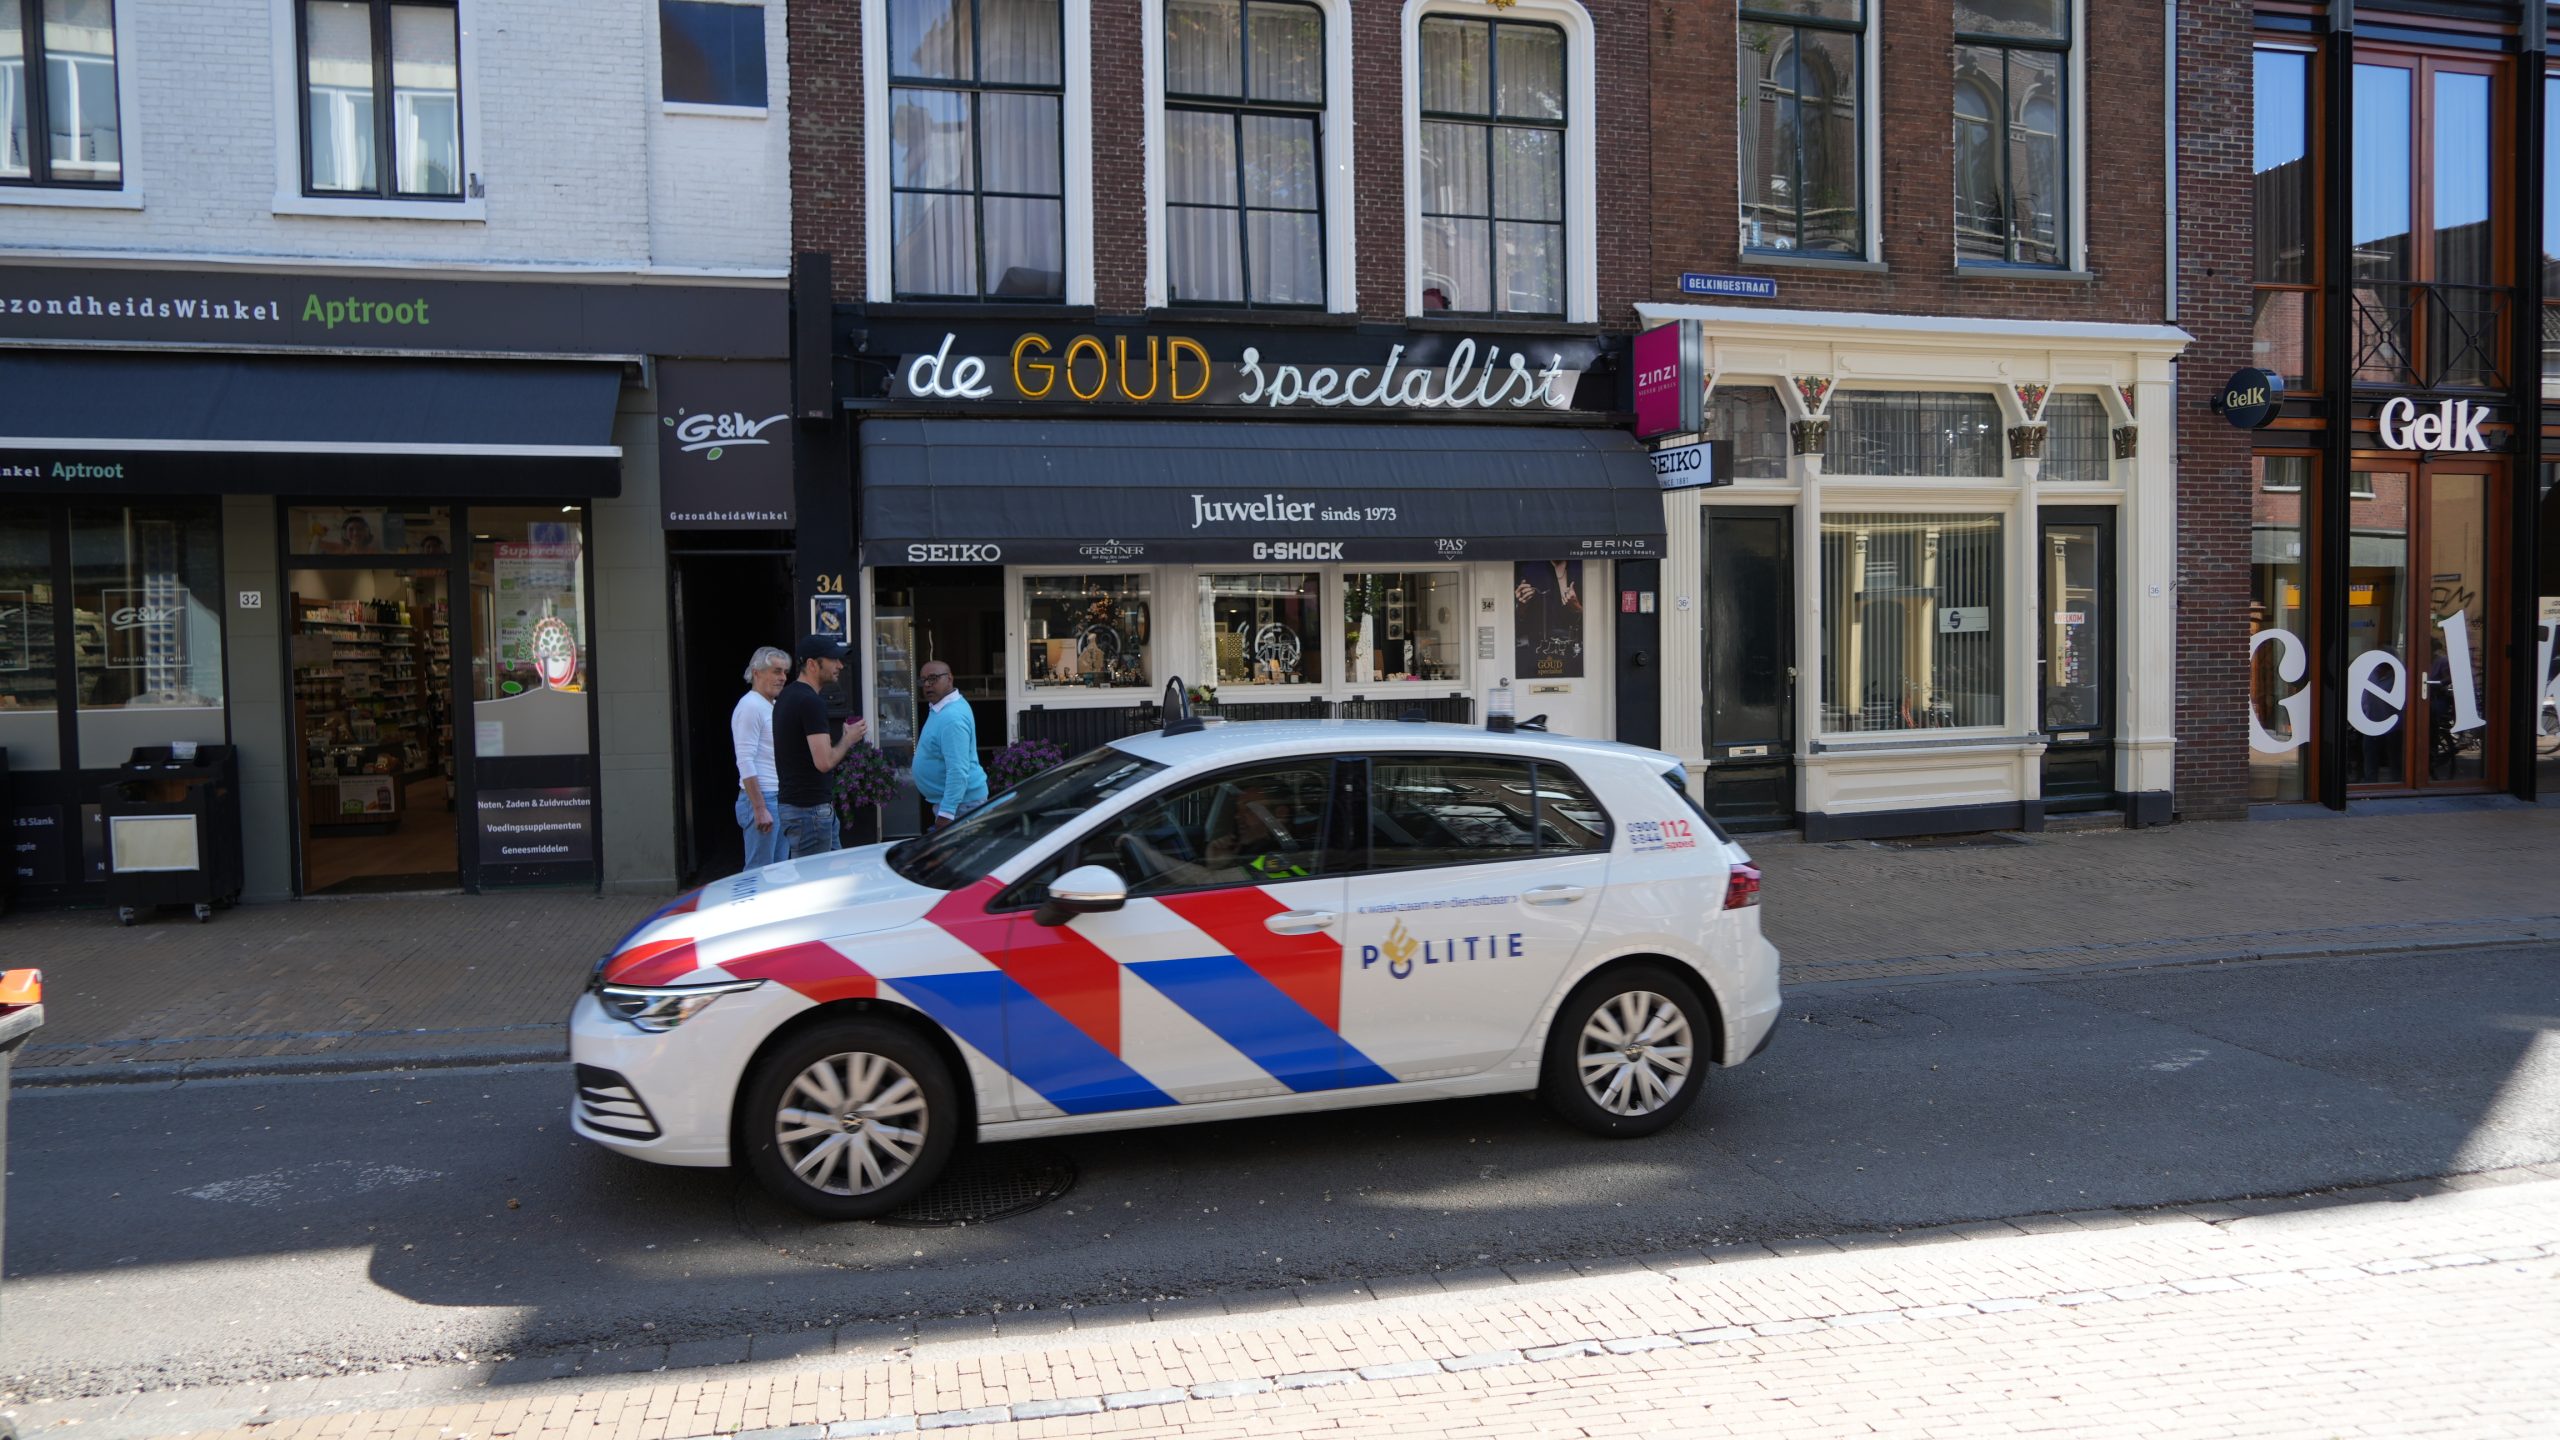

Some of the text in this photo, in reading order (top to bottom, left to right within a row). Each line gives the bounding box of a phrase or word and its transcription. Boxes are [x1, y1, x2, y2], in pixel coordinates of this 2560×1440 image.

[1689, 277, 1770, 293] GELKINGESTRAAT
[302, 293, 430, 329] Aptroot
[907, 332, 1565, 408] de GOUD specialist
[2226, 385, 2265, 407] Gelk
[676, 411, 789, 443] G&W
[2379, 397, 2490, 451] Gelk
[52, 462, 124, 481] Aptroot
[670, 511, 788, 521] GezondheidsWinkel
[1191, 493, 1397, 529] Juwelier sinds 1973
[907, 543, 1001, 563] SEIKO
[1079, 546, 1144, 555] GERSTNER
[1253, 542, 1344, 560] G-SHOCK
[1439, 538, 1463, 551] PAS
[1582, 540, 1645, 548] BERING
[816, 574, 843, 593] 34
[242, 594, 259, 606] 32
[477, 798, 591, 810] Noten, Zaden & Zuidvruchten
[28, 816, 54, 826] Slank
[486, 821, 582, 834] Voedingssupplementen
[1659, 819, 1693, 838] 112
[502, 844, 569, 855] Geneesmiddelen
[1361, 932, 1523, 979] POLITIE
